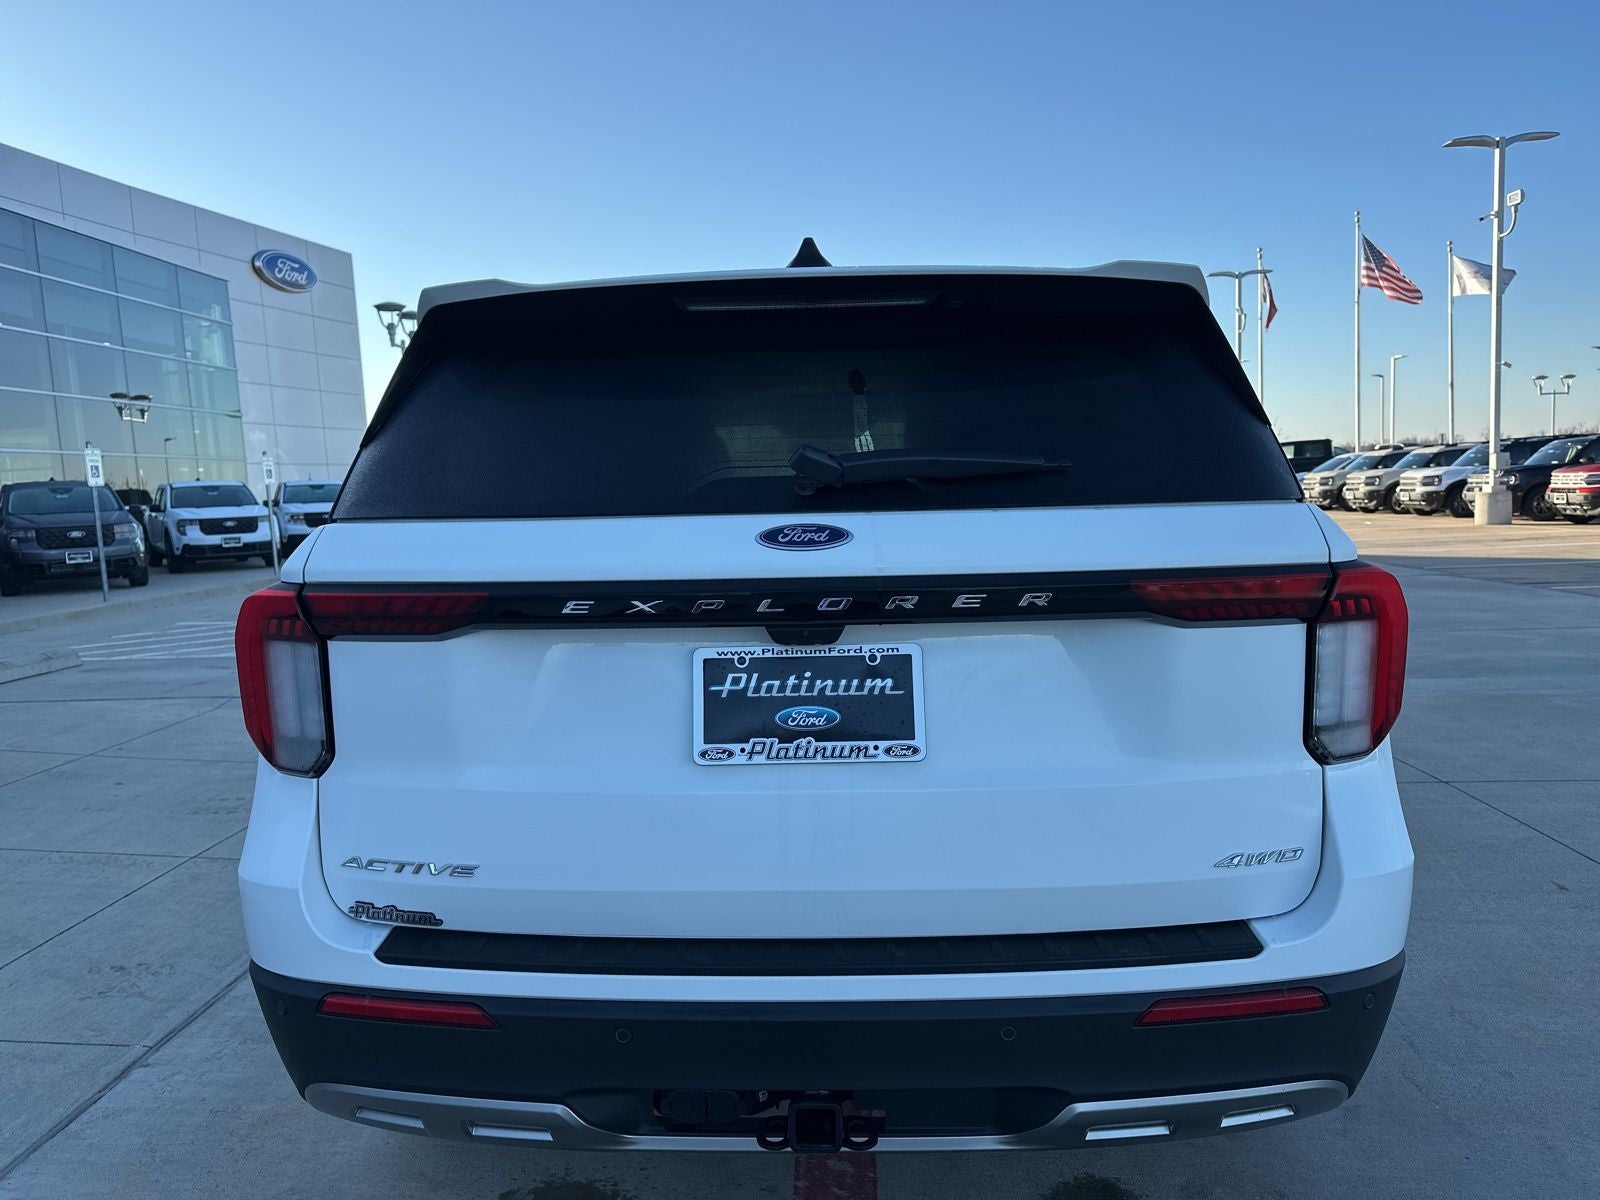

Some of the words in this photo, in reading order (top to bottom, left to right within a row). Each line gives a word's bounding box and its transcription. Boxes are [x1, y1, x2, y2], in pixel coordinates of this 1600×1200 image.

[275, 258, 308, 284] Ford
[778, 526, 830, 542] Ford
[561, 593, 1053, 614] EXPLORER
[716, 646, 900, 657] www.PlatinumFord.com
[708, 671, 905, 698] Platinum
[787, 709, 827, 727] Ford
[704, 749, 730, 759] Ford
[738, 738, 879, 761] Platinum
[889, 745, 914, 756] Ford
[341, 856, 480, 877] ACTIVE
[1213, 846, 1304, 868] 4WD
[348, 900, 444, 927] Platinum
